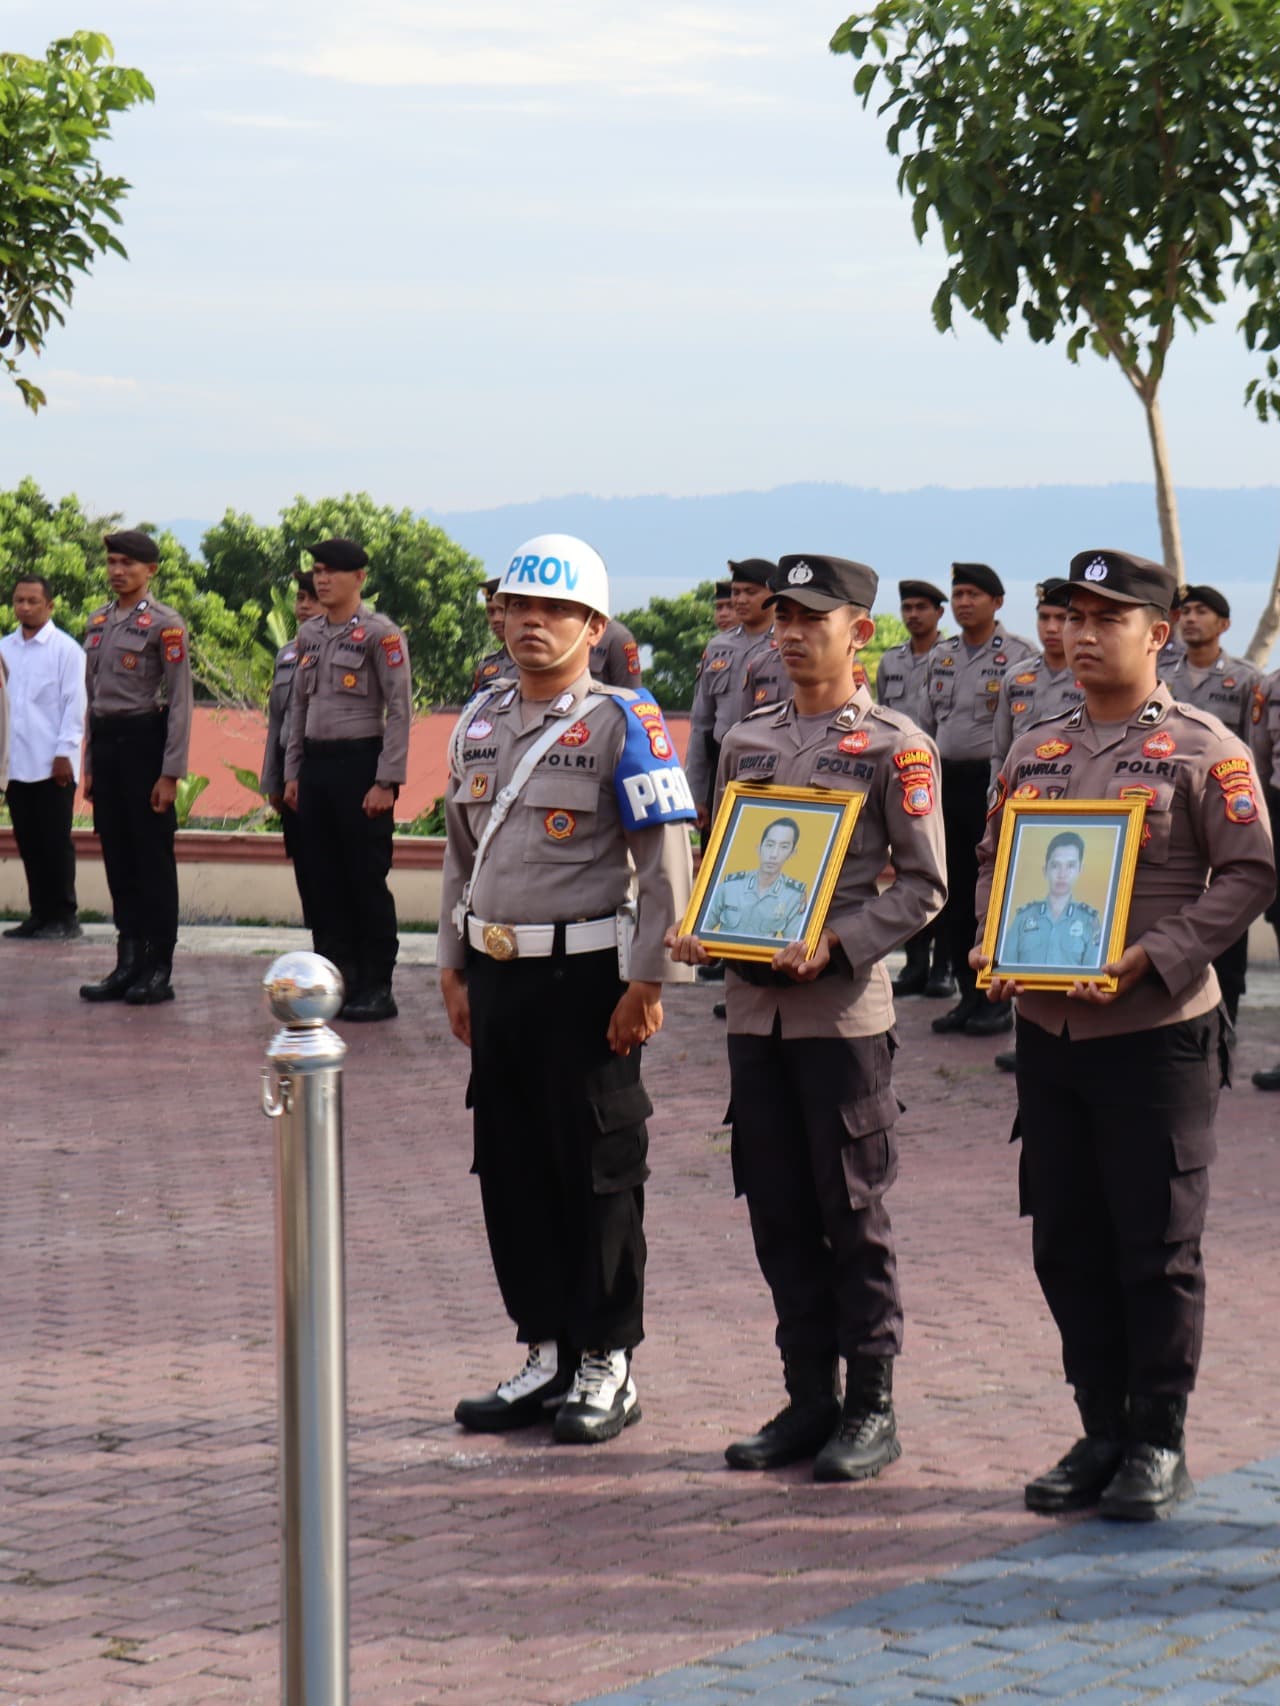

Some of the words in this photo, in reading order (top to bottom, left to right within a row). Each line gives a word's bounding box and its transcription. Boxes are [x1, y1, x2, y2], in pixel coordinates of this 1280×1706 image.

[504, 555, 579, 591] PROV
[816, 756, 874, 780] POLRI
[1115, 760, 1177, 778] POLRI
